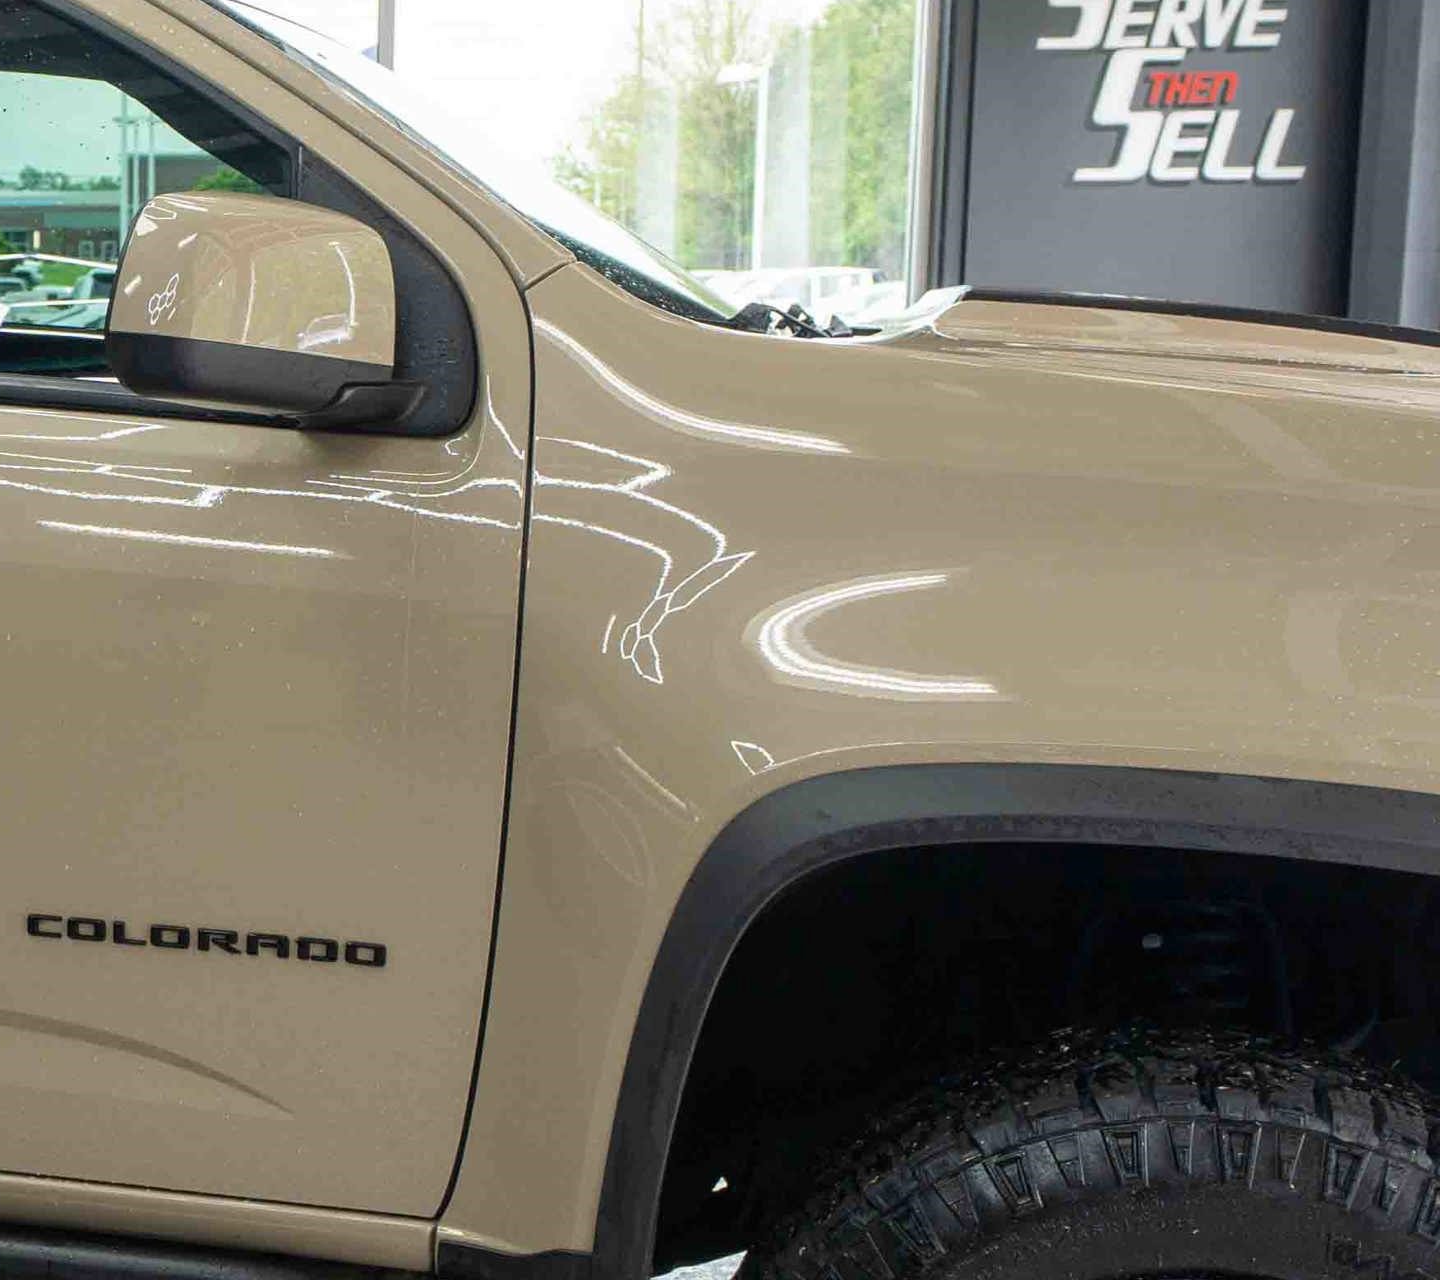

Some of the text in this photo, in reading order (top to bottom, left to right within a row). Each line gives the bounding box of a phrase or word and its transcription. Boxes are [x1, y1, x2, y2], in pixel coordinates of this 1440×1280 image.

[1072, 47, 1307, 182] SELL
[1147, 70, 1240, 106] THEN
[26, 913, 387, 968] COLORADO
